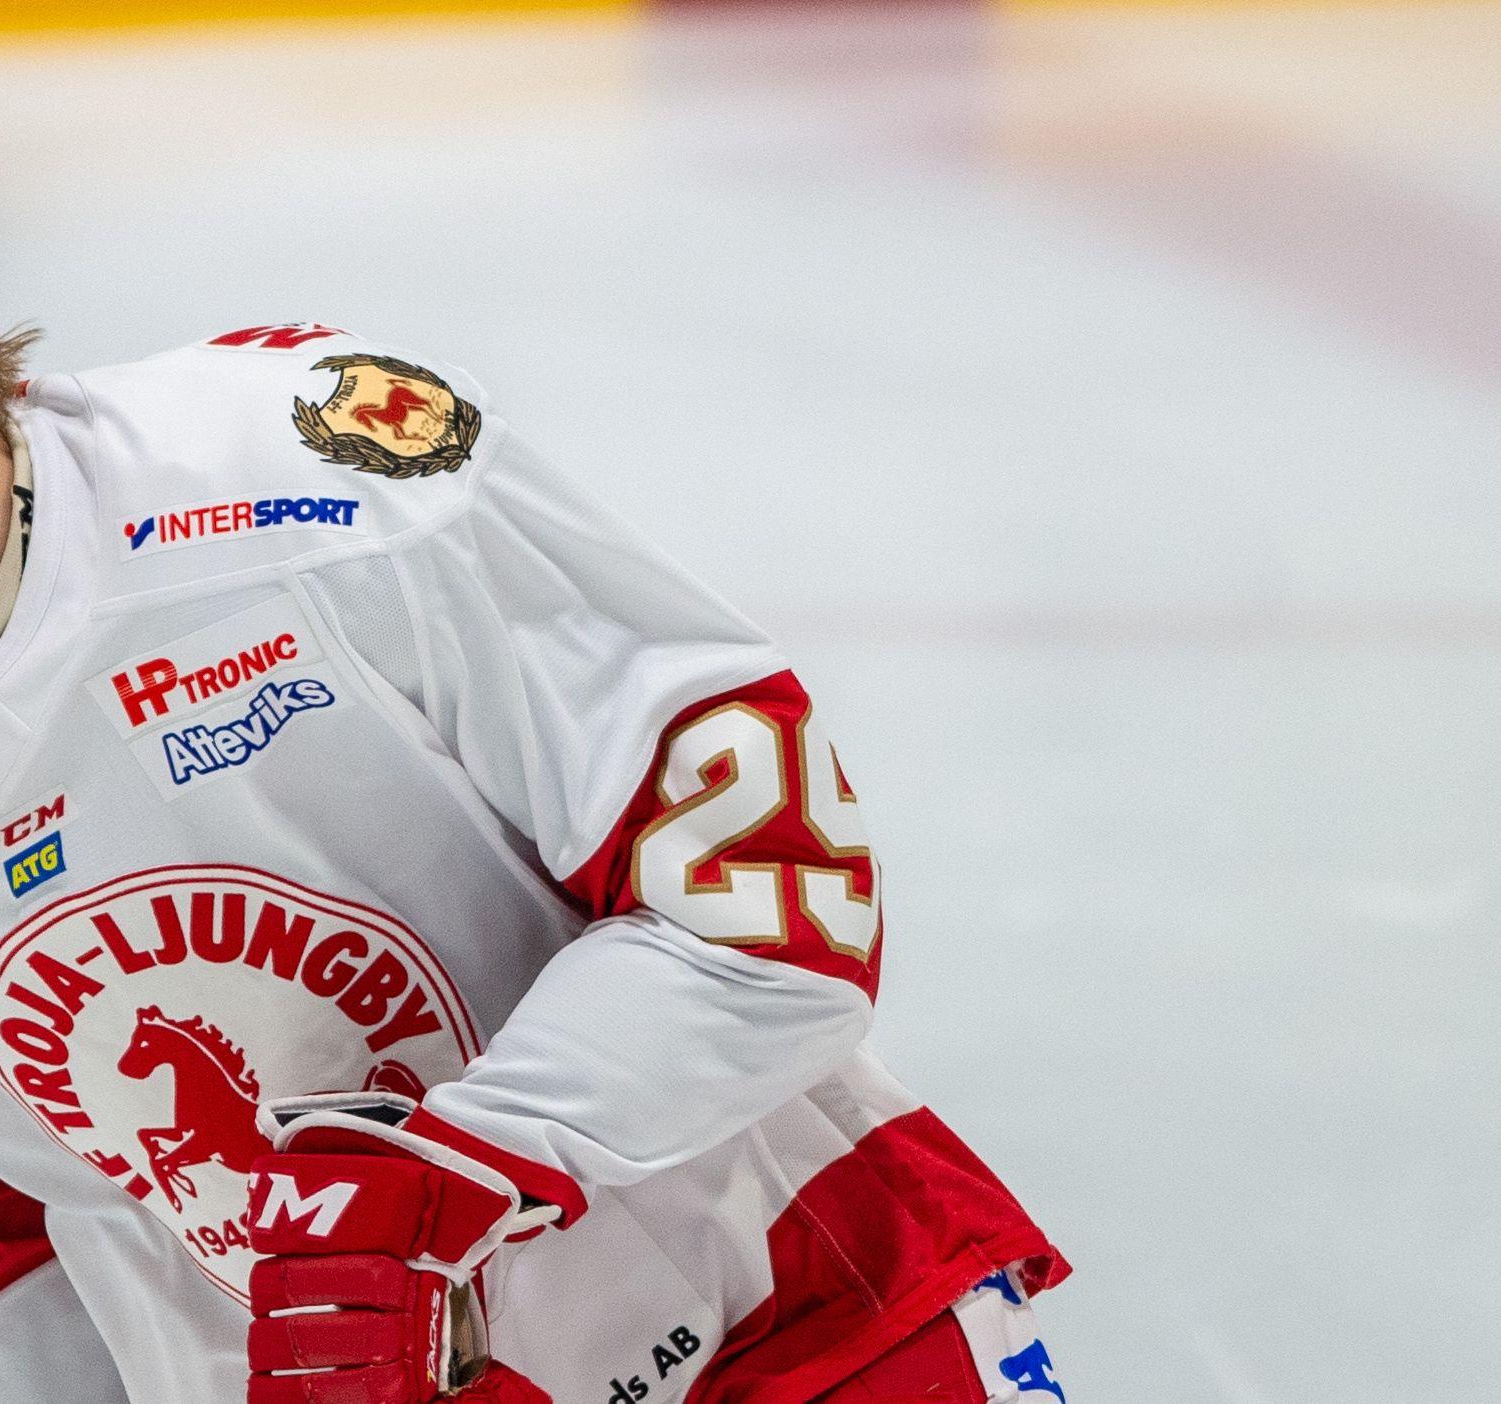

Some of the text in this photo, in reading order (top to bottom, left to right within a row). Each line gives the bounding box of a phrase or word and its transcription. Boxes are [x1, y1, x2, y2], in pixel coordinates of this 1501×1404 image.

[159, 497, 360, 544] INTERSPORT
[162, 679, 335, 784] Atteviks
[12, 842, 58, 890] ATG
[185, 1212, 250, 1258] 194
[651, 1325, 701, 1380] AB
